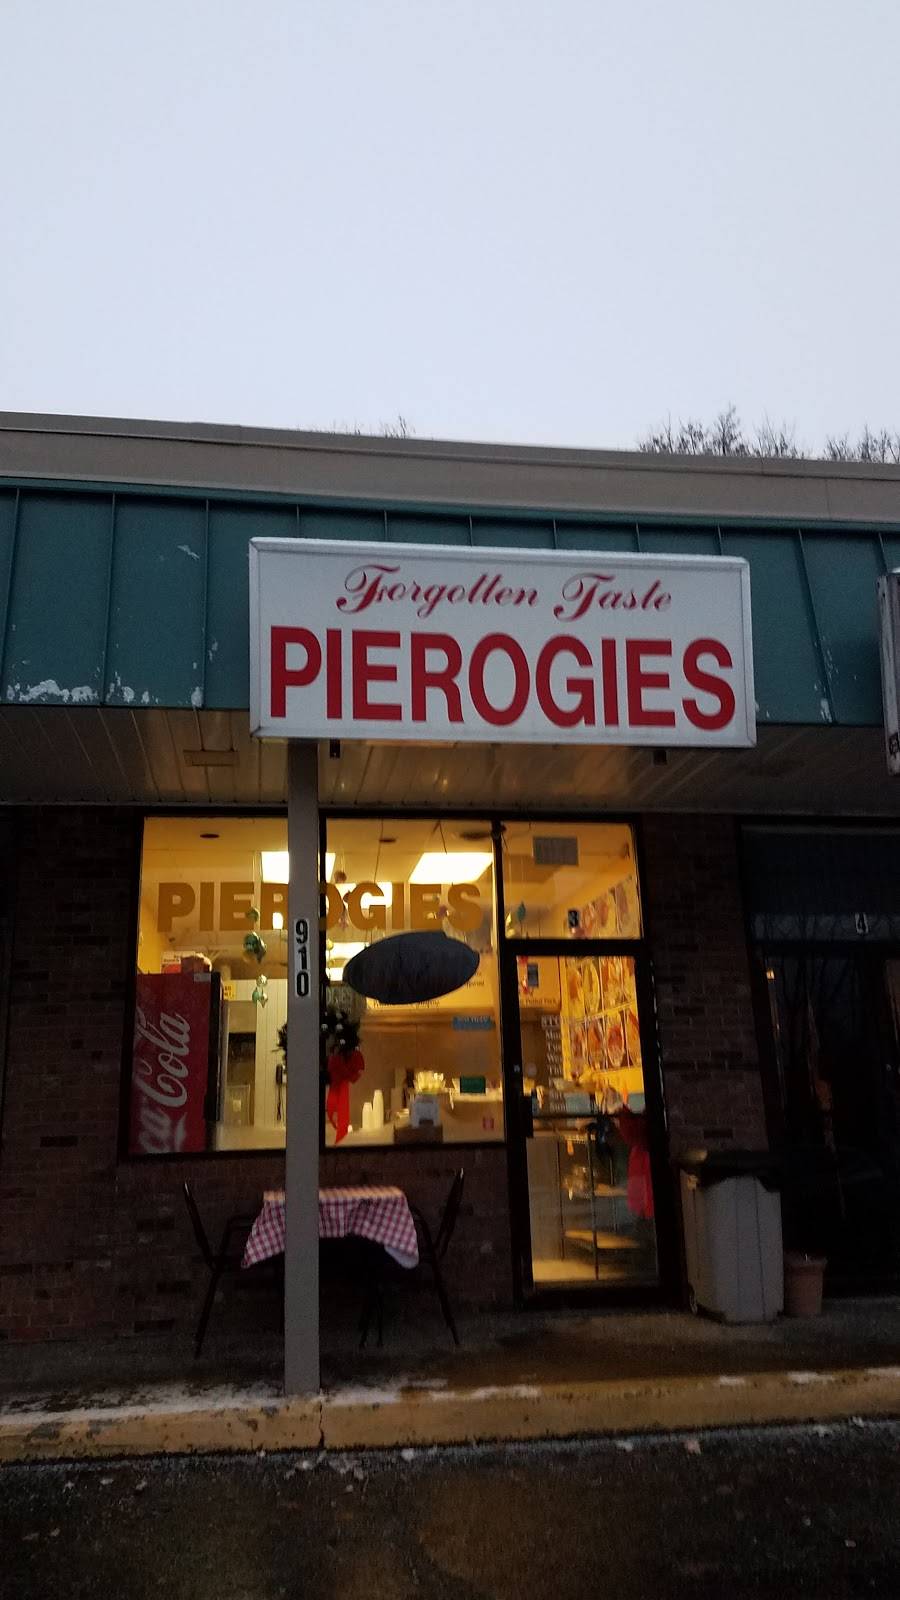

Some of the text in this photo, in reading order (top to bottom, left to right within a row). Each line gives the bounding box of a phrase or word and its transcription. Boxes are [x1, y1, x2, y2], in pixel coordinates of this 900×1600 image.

[336, 564, 671, 622] Forgotten Taste
[270, 625, 736, 730] PIEROGIES
[295, 919, 309, 997] 910
